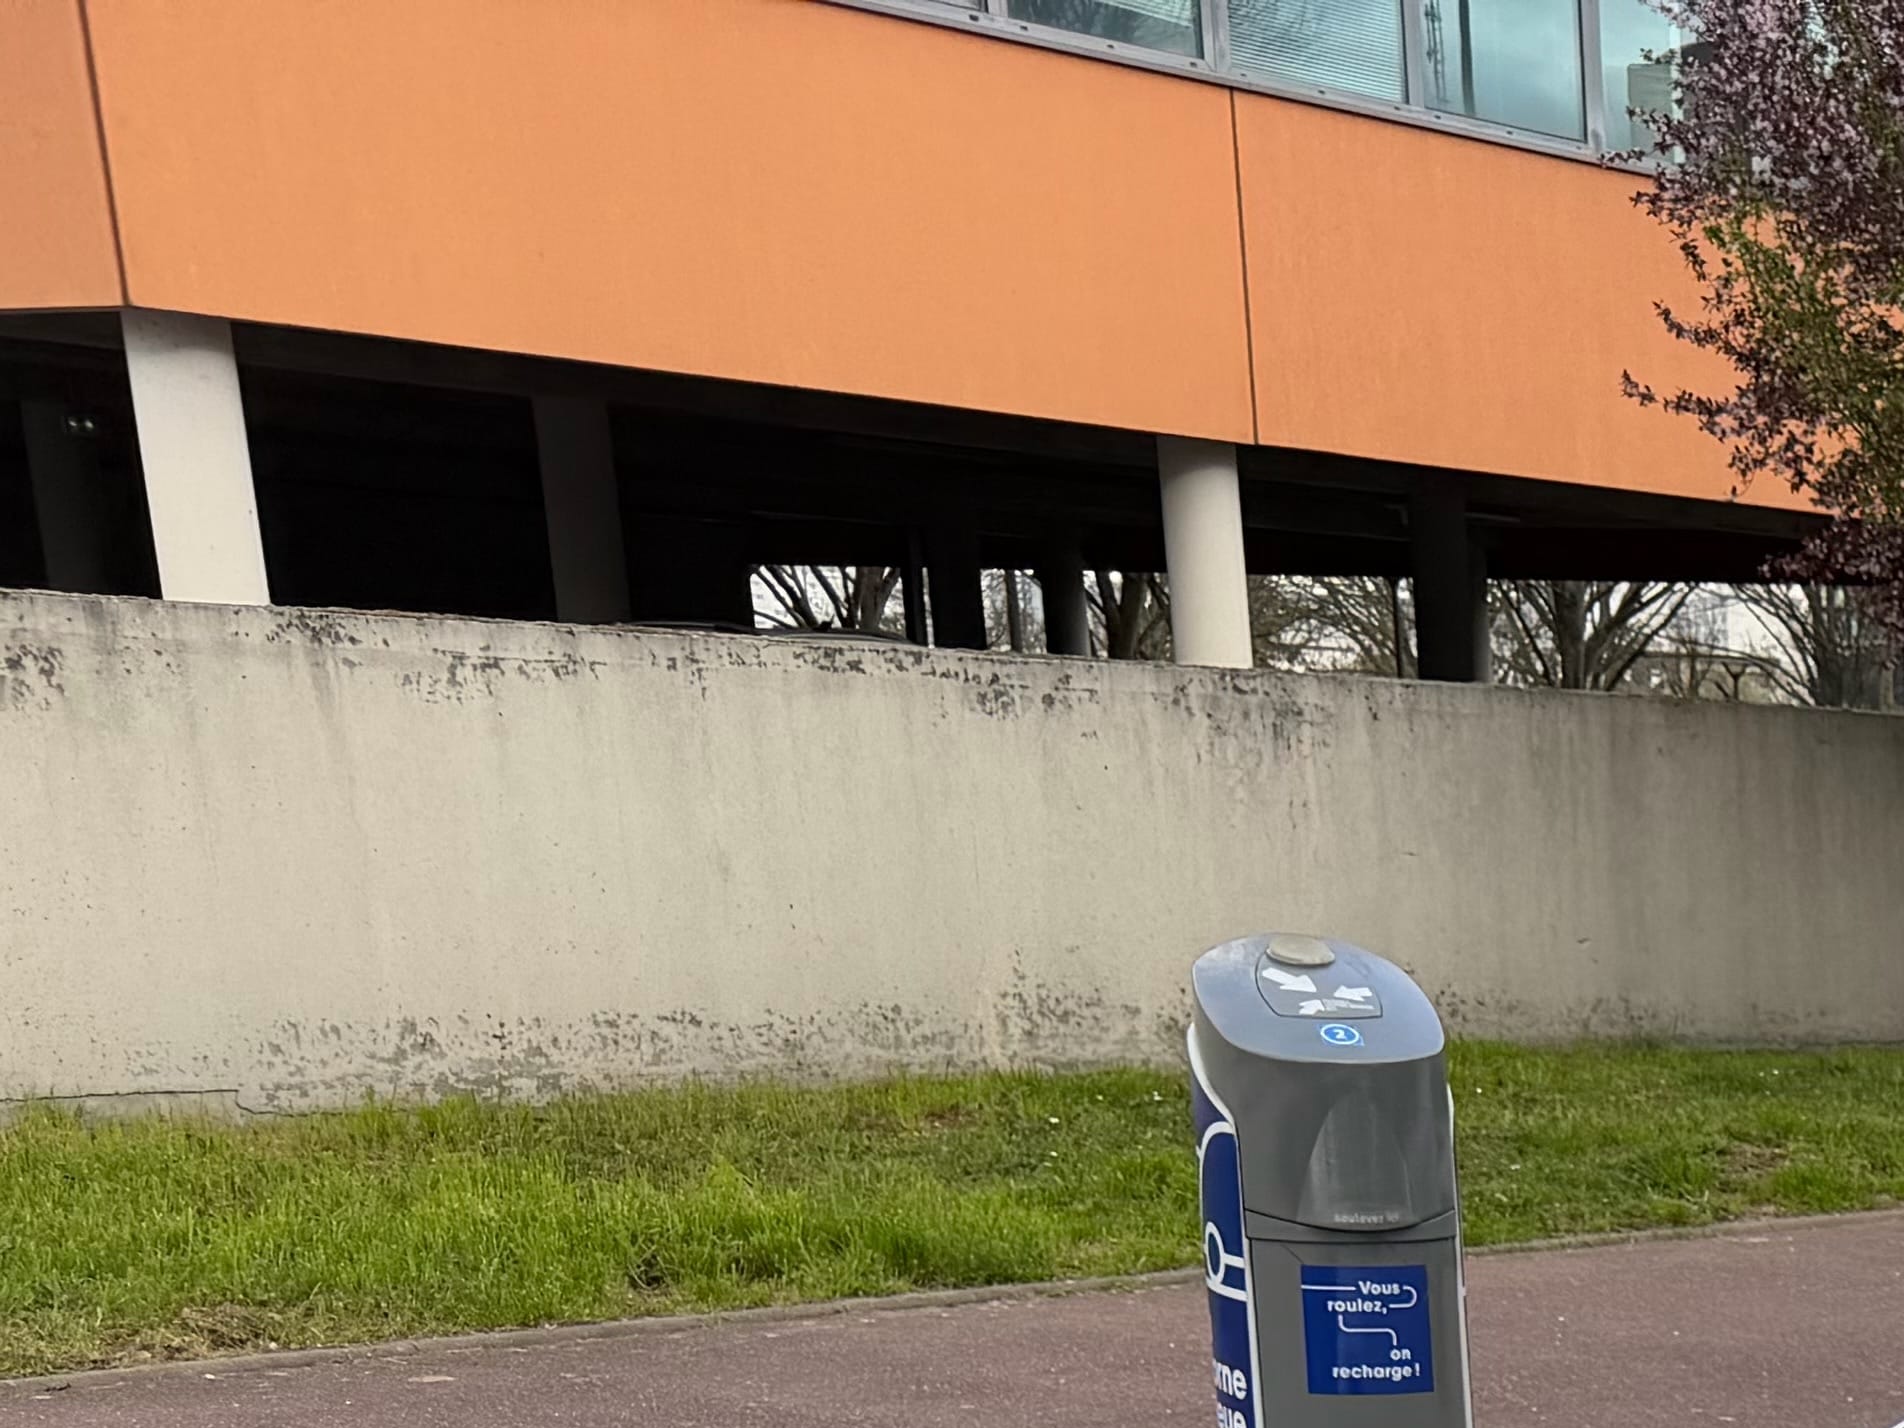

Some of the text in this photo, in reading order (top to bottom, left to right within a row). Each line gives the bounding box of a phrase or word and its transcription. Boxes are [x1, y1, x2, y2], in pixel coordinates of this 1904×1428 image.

[1334, 1027, 1347, 1040] 2
[1358, 1280, 1401, 1296] Vous
[1327, 1298, 1388, 1315] roulez,
[1389, 1348, 1412, 1361] on
